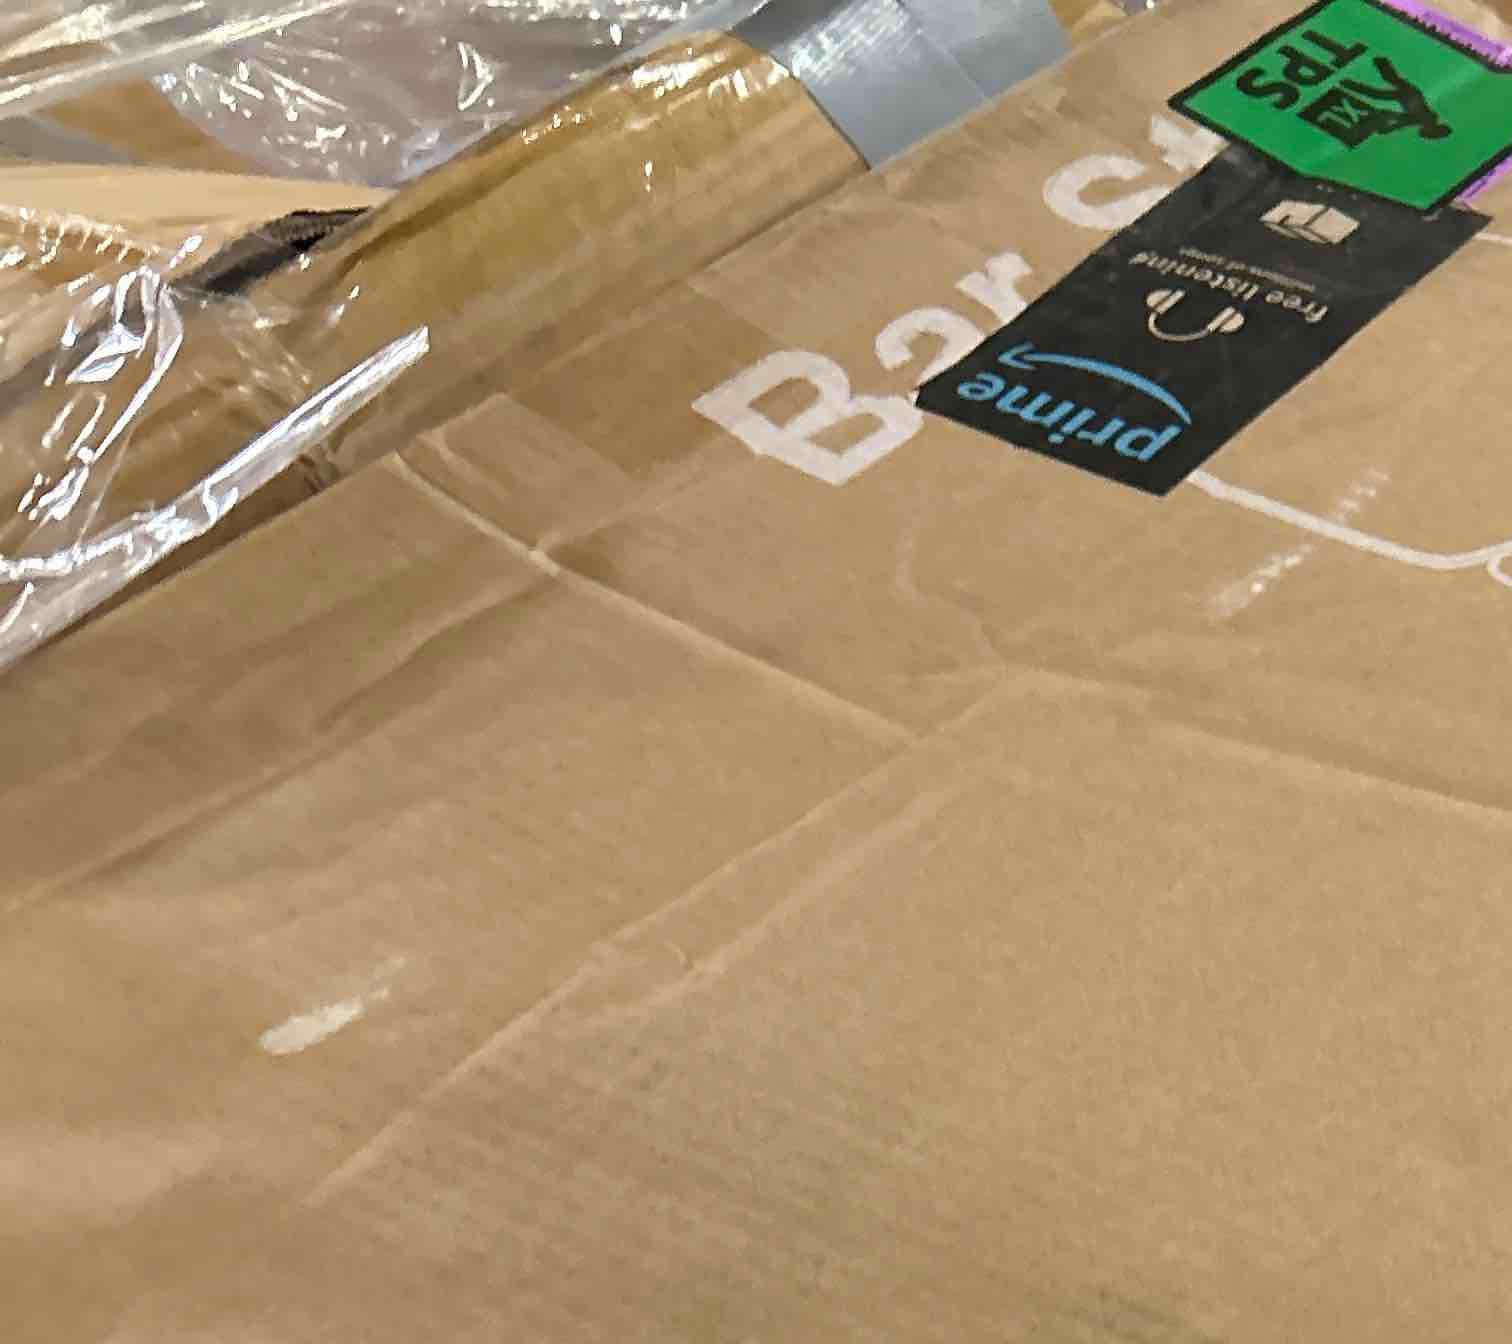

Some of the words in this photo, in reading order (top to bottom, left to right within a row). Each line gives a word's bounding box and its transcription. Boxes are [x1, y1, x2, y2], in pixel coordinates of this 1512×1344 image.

[1235, 29, 1368, 111] TPS
[1264, 289, 1330, 324] free
[957, 370, 1182, 462] prime
